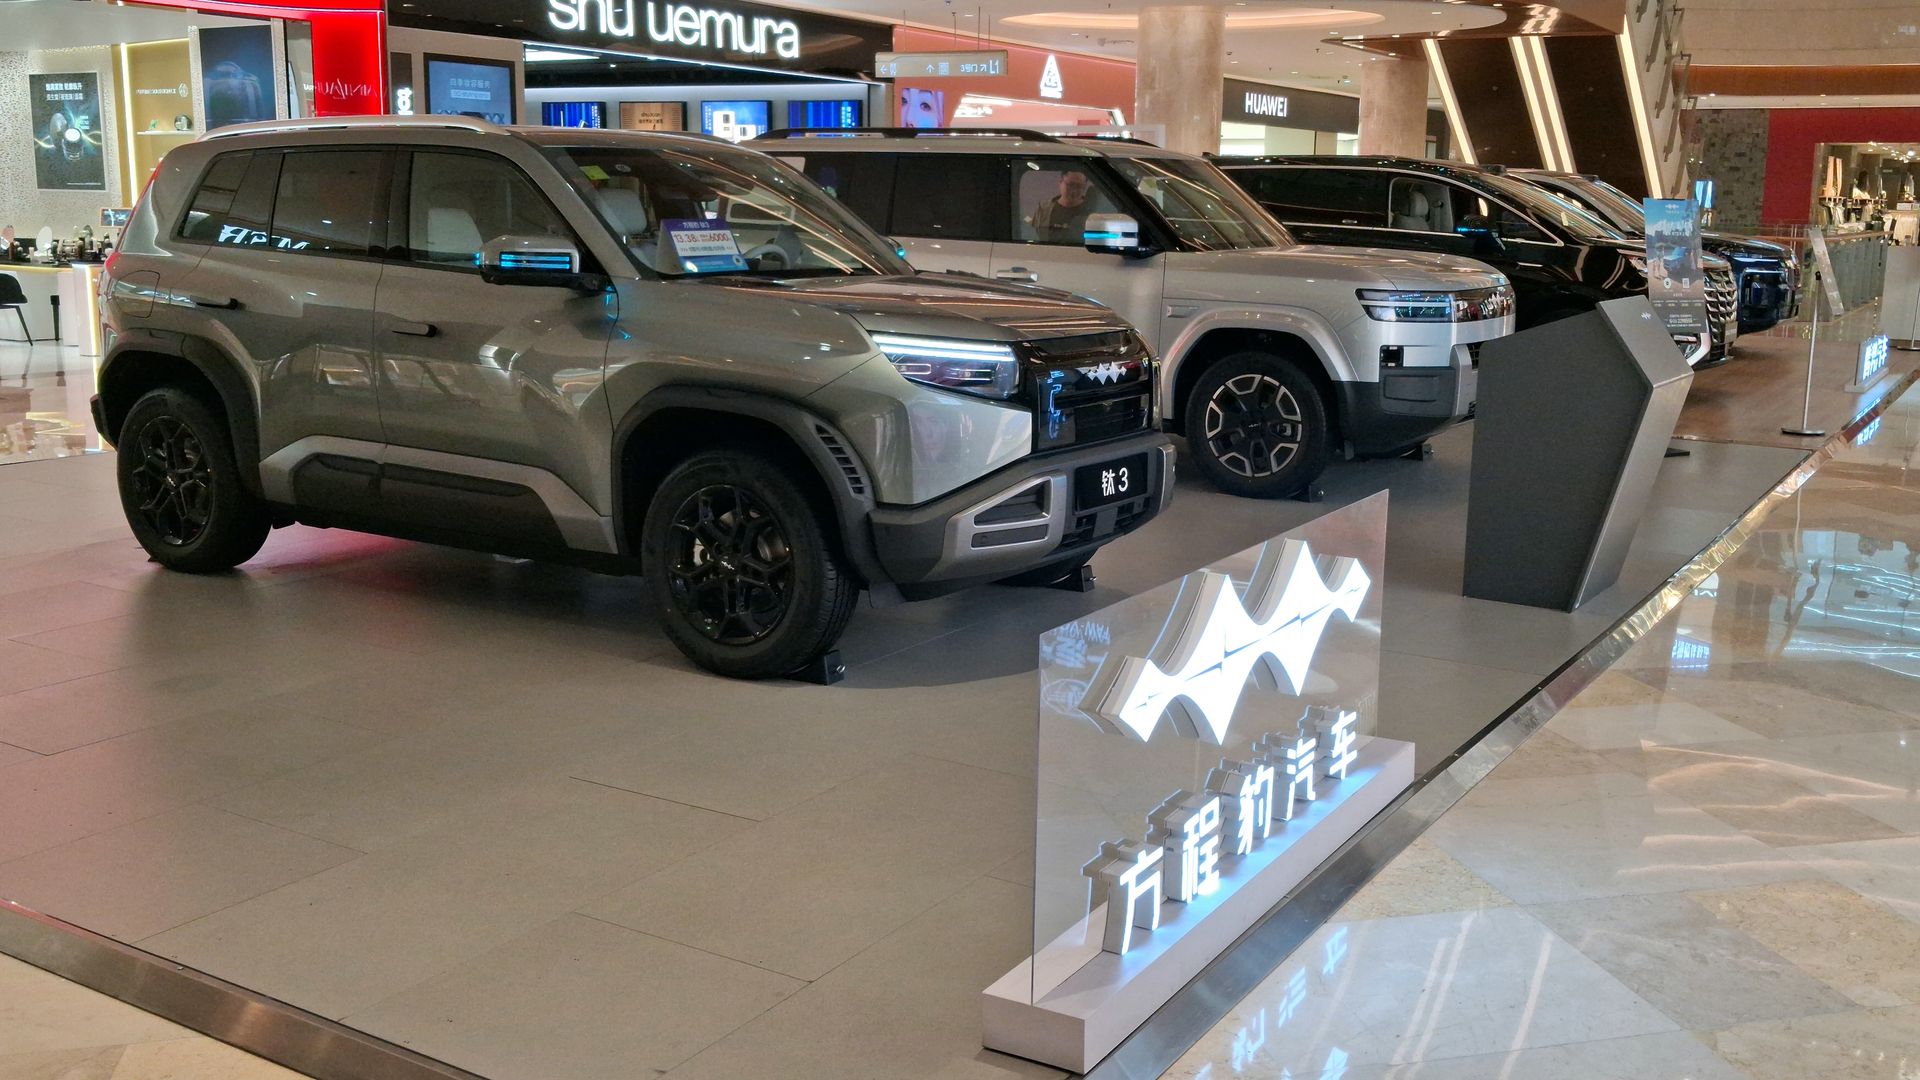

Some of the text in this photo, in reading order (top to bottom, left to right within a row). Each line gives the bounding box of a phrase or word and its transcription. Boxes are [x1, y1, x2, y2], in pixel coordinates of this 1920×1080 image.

[647, 1, 800, 58] uemura
[1245, 92, 1288, 118] HUAWEI
[1119, 710, 1359, 956] 方程豹汽车
